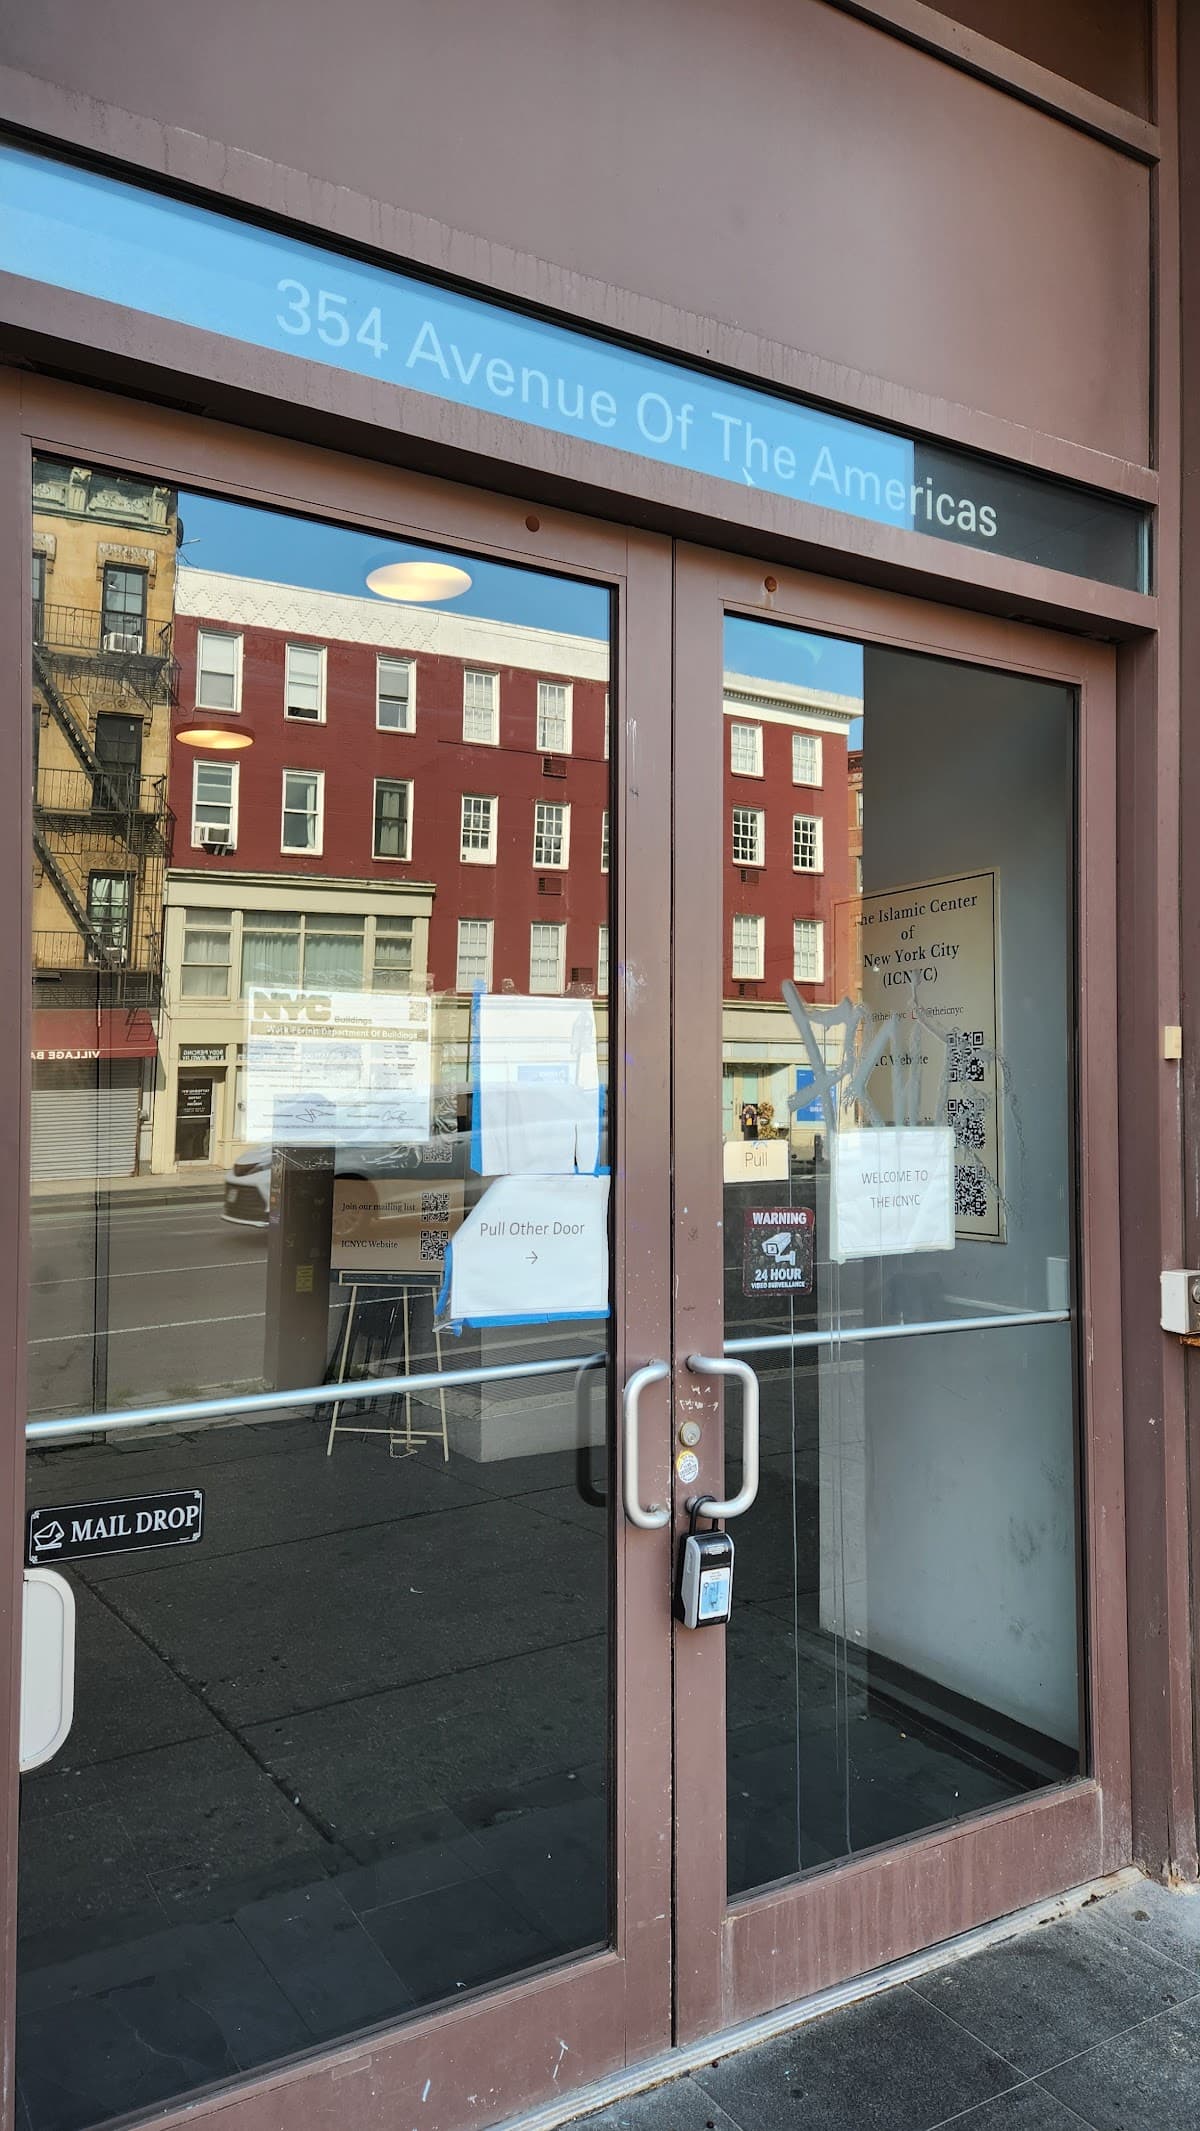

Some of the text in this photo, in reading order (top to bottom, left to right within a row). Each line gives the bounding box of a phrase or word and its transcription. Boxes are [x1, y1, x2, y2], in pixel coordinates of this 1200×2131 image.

[275, 278, 999, 538] 354 Avenue Of The Americas
[879, 902, 926, 922] Islamic
[930, 895, 978, 913] Center
[901, 925, 916, 940] of
[864, 943, 960, 968] New York City
[883, 966, 938, 989] (ICNC)
[253, 991, 332, 1022] NYC
[334, 1016, 373, 1026] Buildings
[382, 1030, 418, 1040] Buildings
[745, 1151, 769, 1168] Pull
[861, 1170, 929, 1185] WELCOME TO
[341, 1202, 358, 1211] Join
[373, 1202, 402, 1213] mailing
[404, 1202, 415, 1211] list
[871, 1194, 921, 1209] THE ICNYC
[752, 1211, 807, 1225] WARNING
[480, 1221, 585, 1237] Pull Other Door
[341, 1240, 398, 1249] ICNYC Website
[754, 1267, 802, 1282] 24 HOUR
[751, 1281, 806, 1290] VIDEO SURVEILLANCE
[70, 1505, 200, 1543] MAIL DROP
